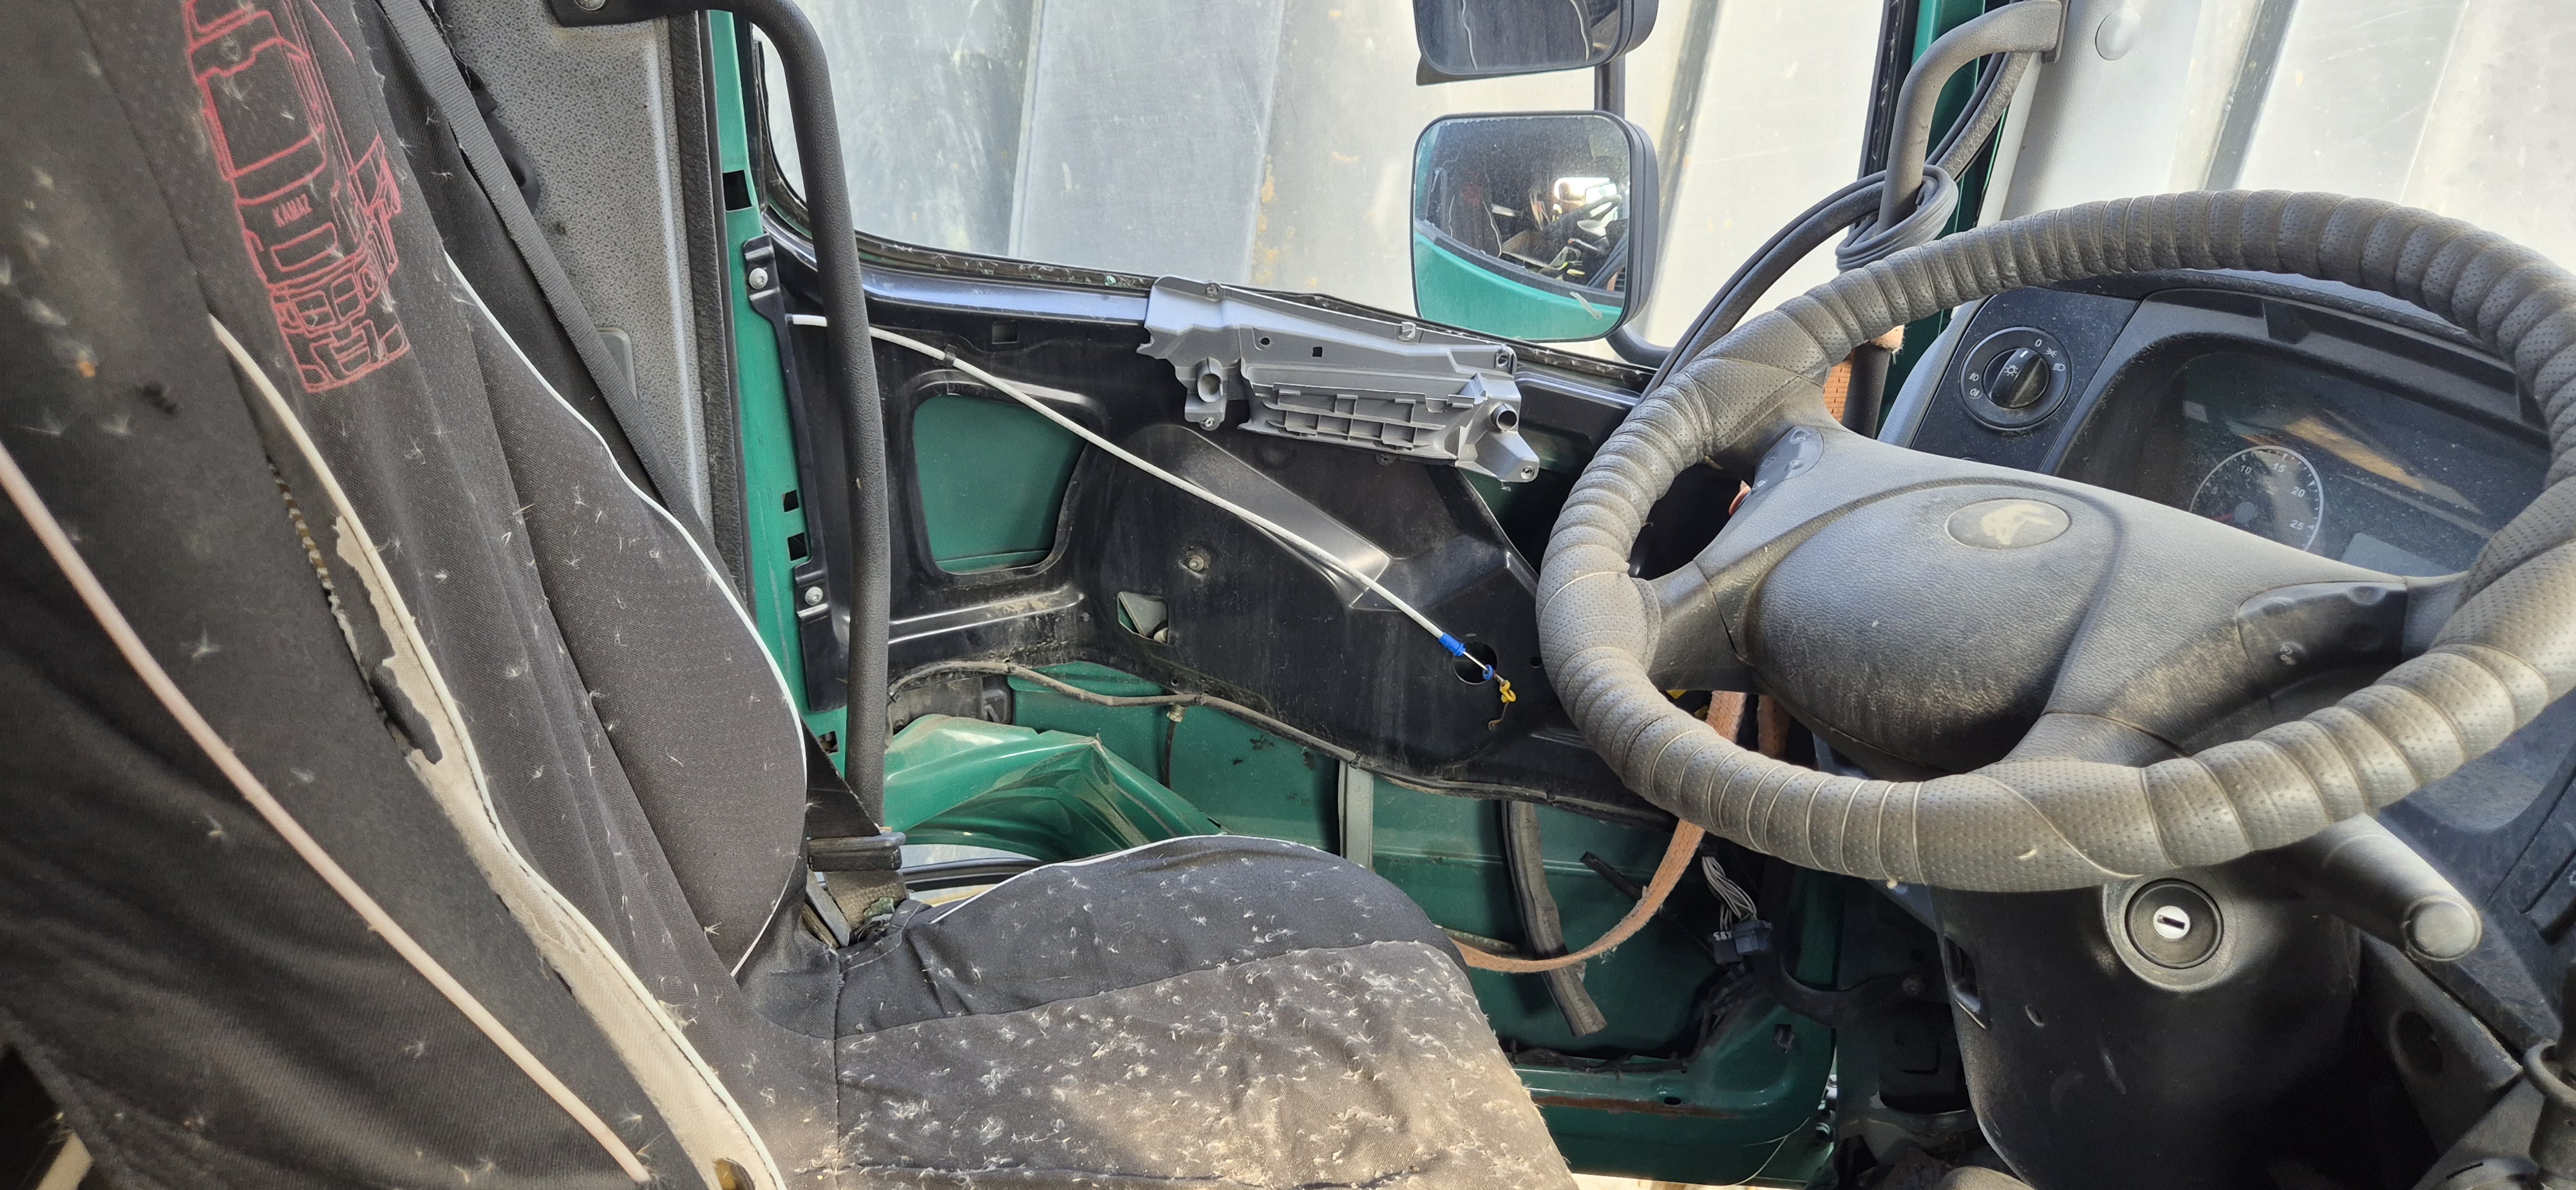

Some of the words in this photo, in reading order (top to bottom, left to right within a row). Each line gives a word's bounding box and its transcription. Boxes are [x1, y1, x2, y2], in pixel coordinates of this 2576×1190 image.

[272, 193, 314, 228] KAMAZ
[2034, 339, 2042, 348] 0
[2239, 464, 2253, 475] 10
[2273, 462, 2286, 473] 15
[2291, 486, 2306, 498] 20
[2289, 519, 2306, 531] 25
